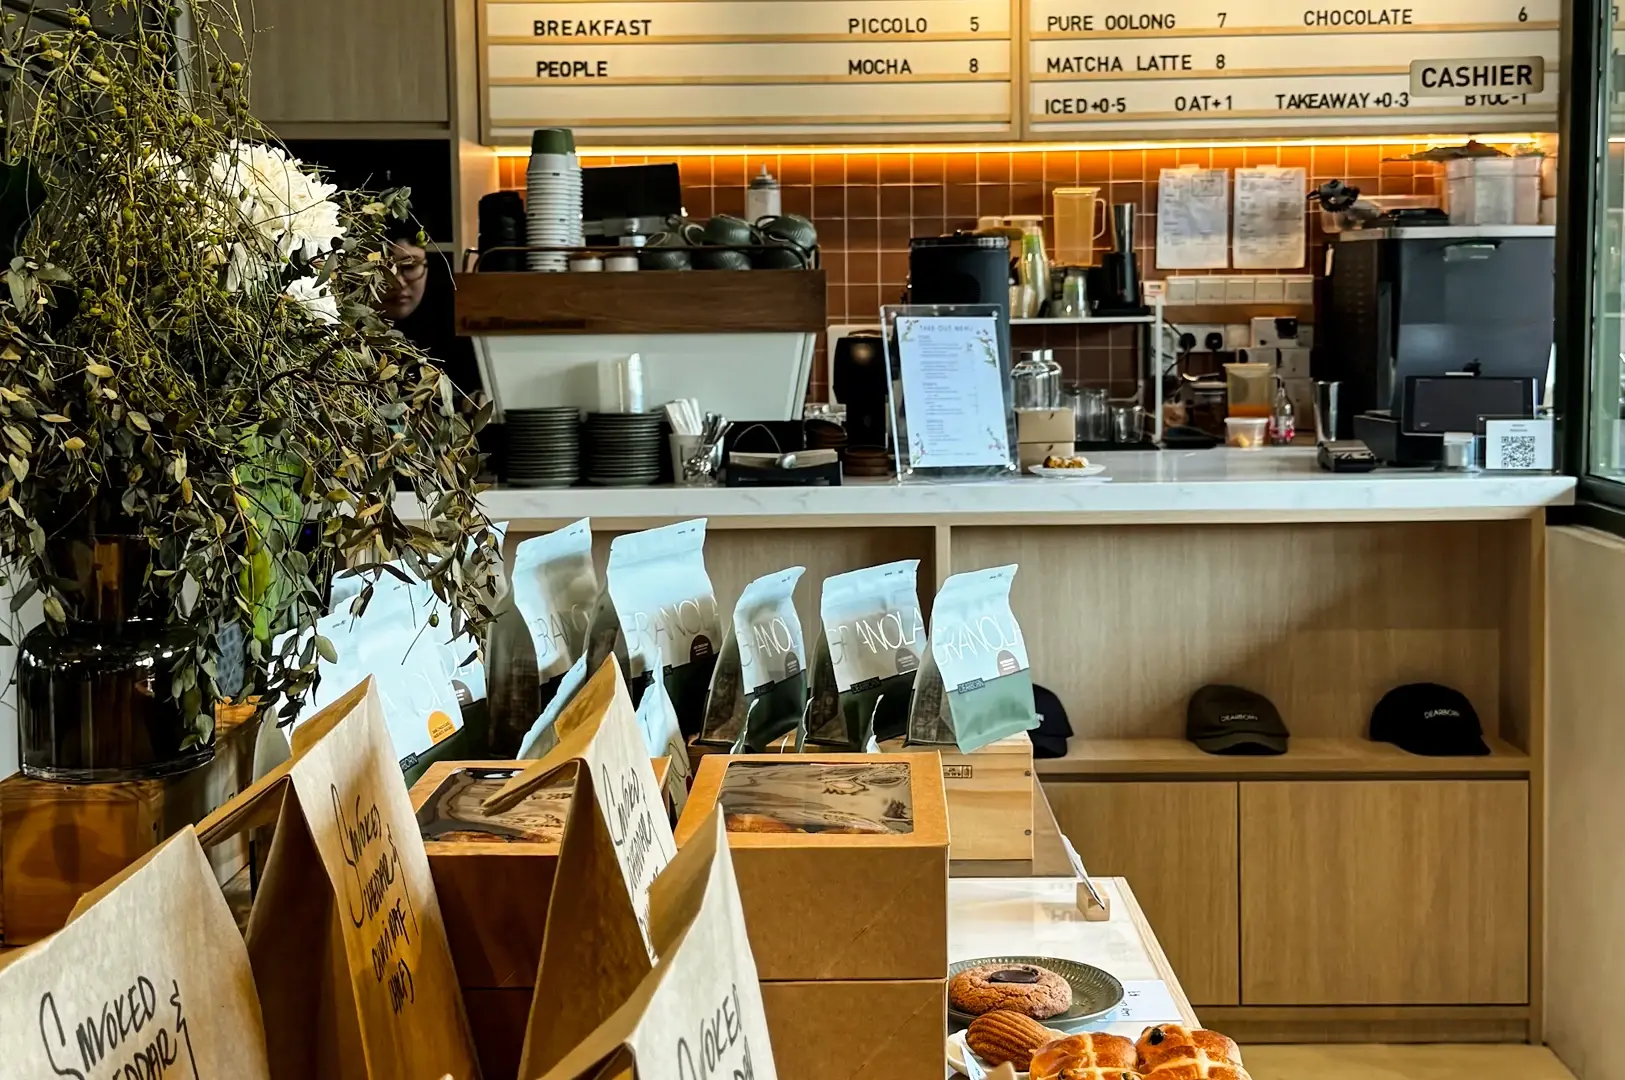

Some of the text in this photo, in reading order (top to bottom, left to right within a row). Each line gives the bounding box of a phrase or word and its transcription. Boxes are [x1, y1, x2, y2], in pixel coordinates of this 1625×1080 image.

[848, 16, 980, 34] PICCOLO 5
[1047, 12, 1227, 32] PURE OOLONG 7
[1303, 6, 1528, 26] CHOCOLATE 6
[533, 19, 652, 36] BREAKFAST
[536, 60, 608, 77] PEOPLE
[848, 58, 979, 75] MOCHA 8
[1047, 54, 1226, 73] MATCHA LATTE 8
[1421, 64, 1533, 88] CASHIER
[39, 975, 157, 1080] SMOKED
